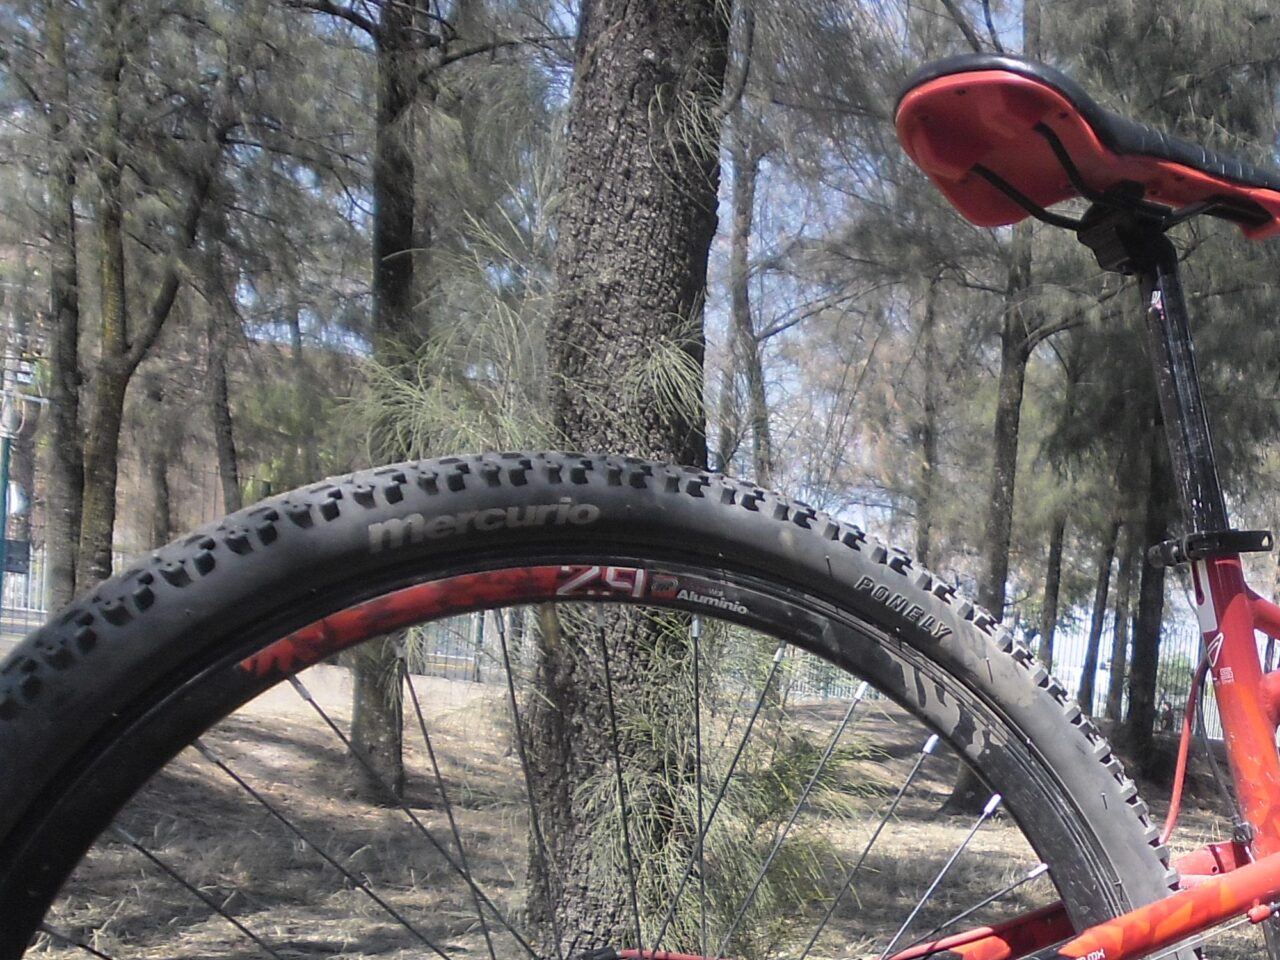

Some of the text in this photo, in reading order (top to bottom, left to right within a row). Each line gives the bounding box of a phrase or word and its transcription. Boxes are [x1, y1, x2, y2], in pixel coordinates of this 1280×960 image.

[367, 497, 600, 554] mercurio
[556, 565, 646, 598] 29
[676, 589, 748, 615] Aluminio
[854, 575, 953, 640] PONELY
